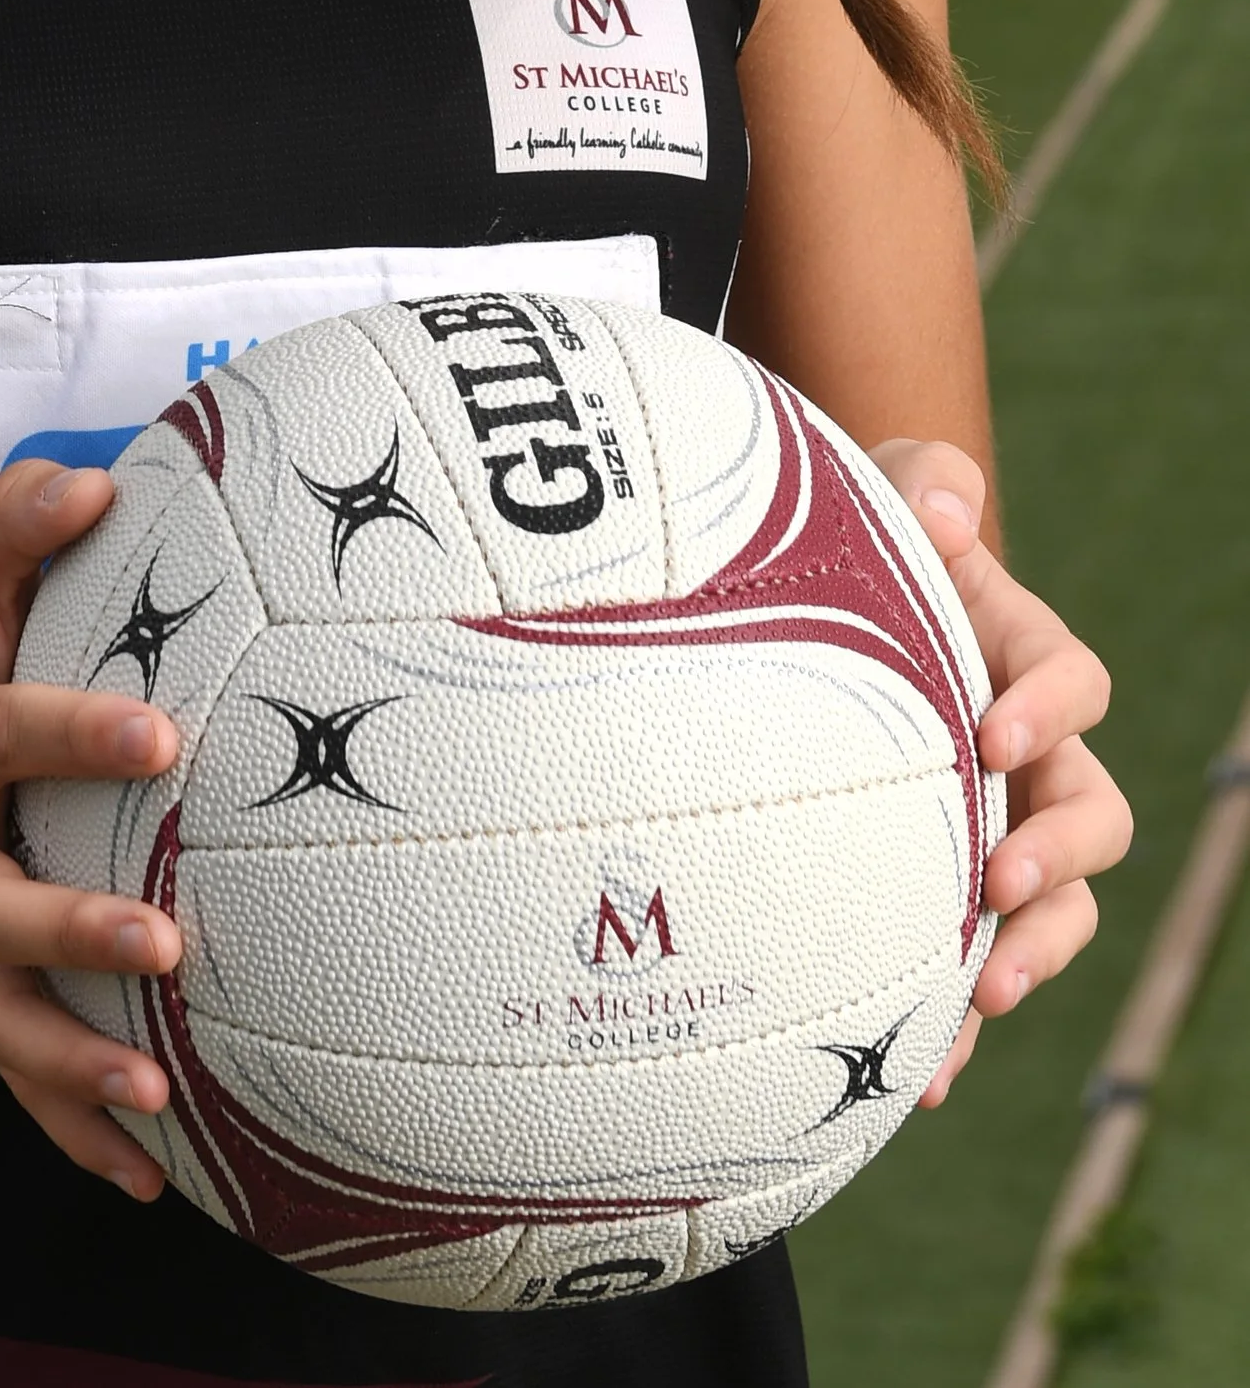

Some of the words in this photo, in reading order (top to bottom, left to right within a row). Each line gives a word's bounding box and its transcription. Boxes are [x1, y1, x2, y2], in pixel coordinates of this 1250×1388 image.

[512, 63, 549, 91] ST
[560, 62, 690, 97] MICHAEL'S
[567, 95, 663, 115] COLLEGE
[527, 127, 576, 159] friendly
[580, 127, 627, 159] learning
[631, 126, 667, 152] Catholic
[567, 1022, 701, 1051] COLLEGE
